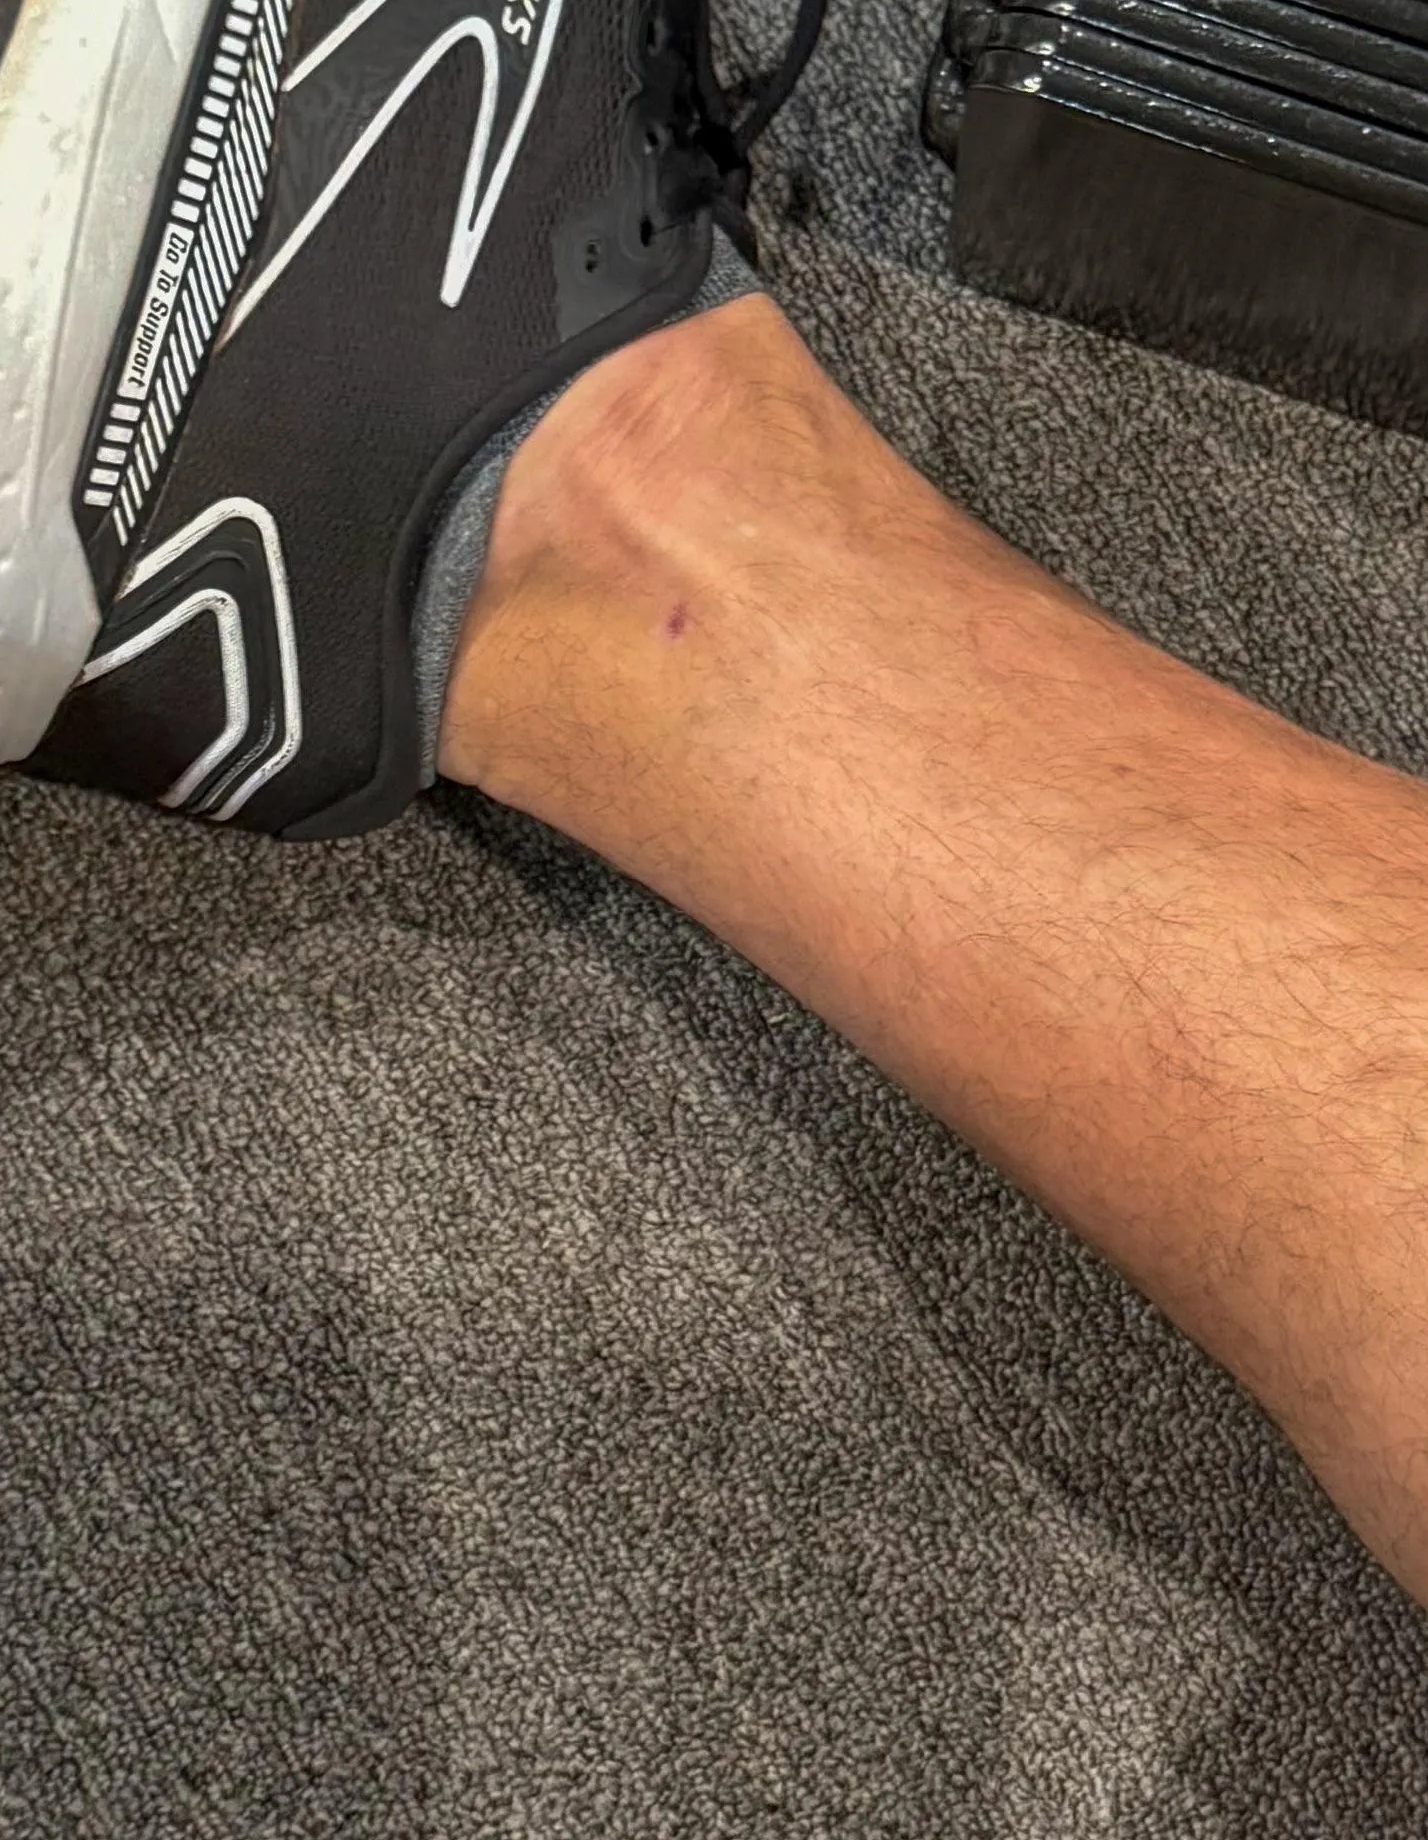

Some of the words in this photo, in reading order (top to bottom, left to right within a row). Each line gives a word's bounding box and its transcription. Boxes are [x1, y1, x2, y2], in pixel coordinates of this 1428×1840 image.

[163, 231, 190, 265] Go
[154, 268, 179, 295] To
[125, 295, 171, 387] Support
